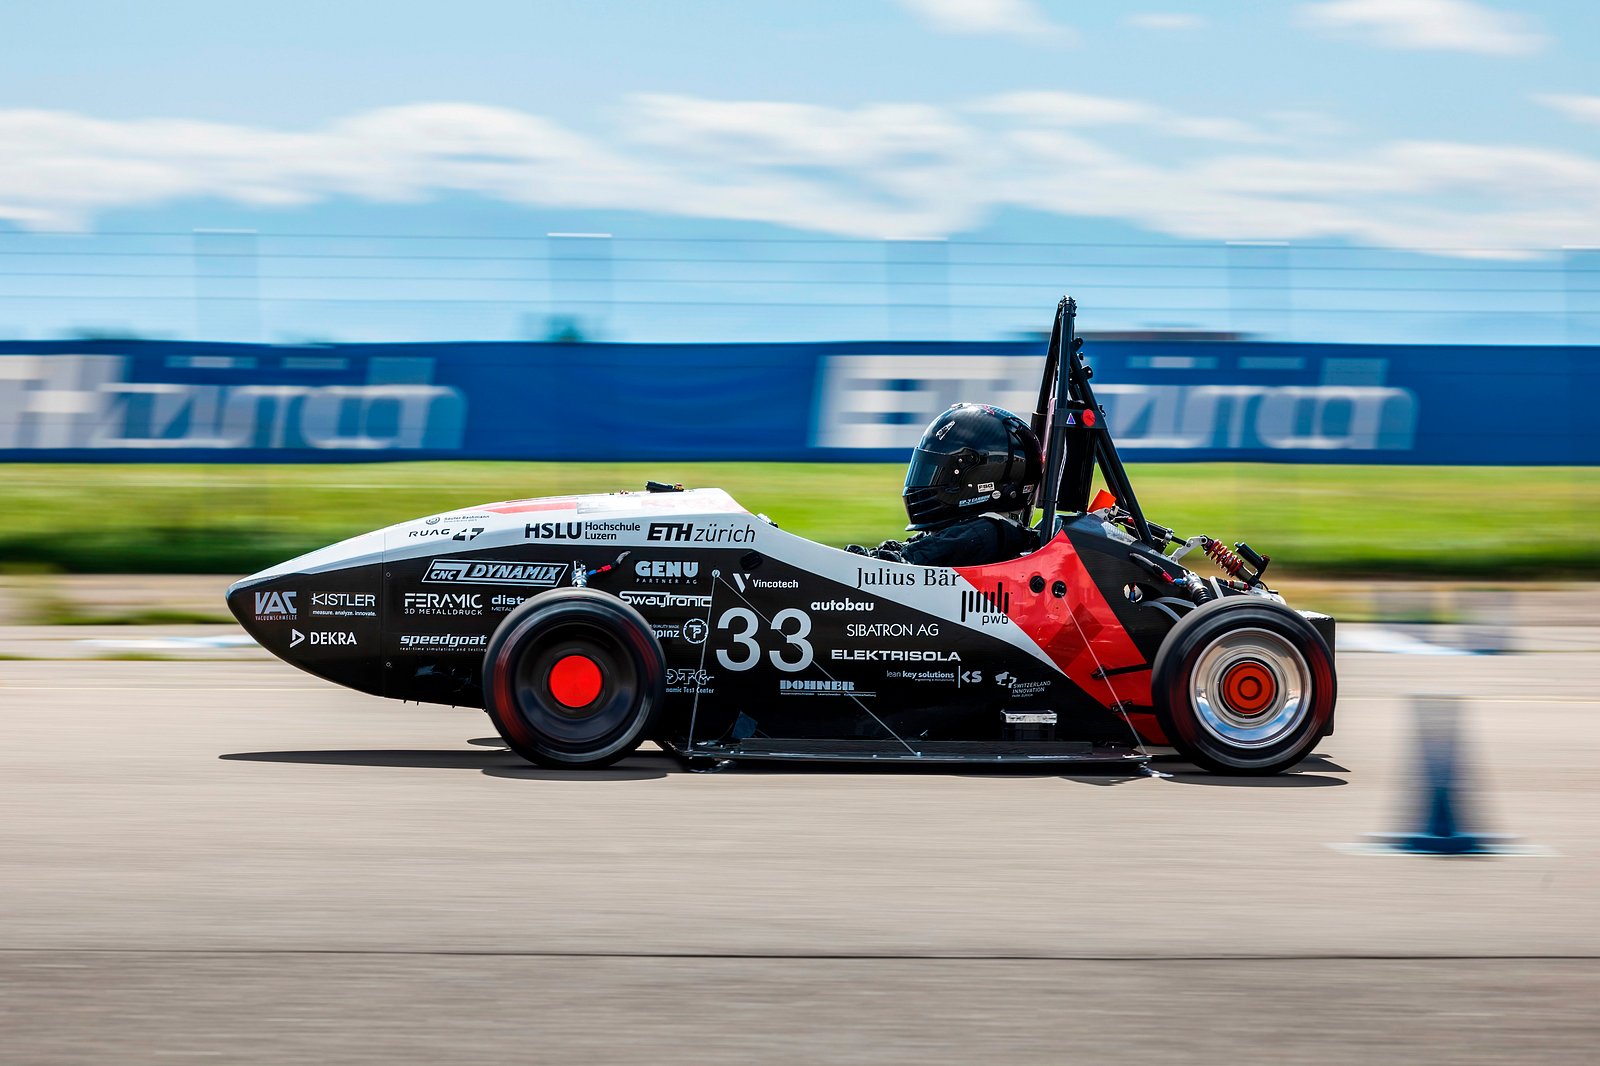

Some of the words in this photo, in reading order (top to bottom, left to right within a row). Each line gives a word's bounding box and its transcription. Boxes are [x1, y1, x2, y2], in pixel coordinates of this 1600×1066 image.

[408, 528, 451, 538] RUAG
[525, 522, 582, 539] HSLU
[584, 522, 641, 532] Hochschule
[646, 523, 694, 541] ETH
[694, 523, 756, 543] zürich
[584, 531, 617, 541] Luzern
[430, 569, 456, 581] CNC
[471, 564, 561, 580] DYNAMIX
[634, 561, 699, 577] GENU
[752, 579, 799, 589] Vincotech
[857, 567, 916, 589] Julius
[923, 568, 961, 587] Bär
[255, 591, 297, 614] VAC
[311, 592, 376, 607] KISTLER
[404, 592, 483, 609] FERAMIC
[810, 598, 874, 611] autobau
[418, 608, 483, 616] METALLDRUCK
[982, 613, 1010, 626] pwb
[846, 623, 913, 637] SIBATRON
[916, 624, 939, 637] AG
[310, 631, 358, 646] DEKRA
[399, 633, 487, 647] speedgoat
[715, 607, 814, 672] 33
[831, 649, 961, 662] ELEKTRISOLA
[886, 670, 900, 678] lean
[902, 670, 916, 680] key
[918, 670, 955, 679] solutions
[780, 680, 855, 690] DOHNER
[1013, 680, 1051, 689] SWITZERLAND
